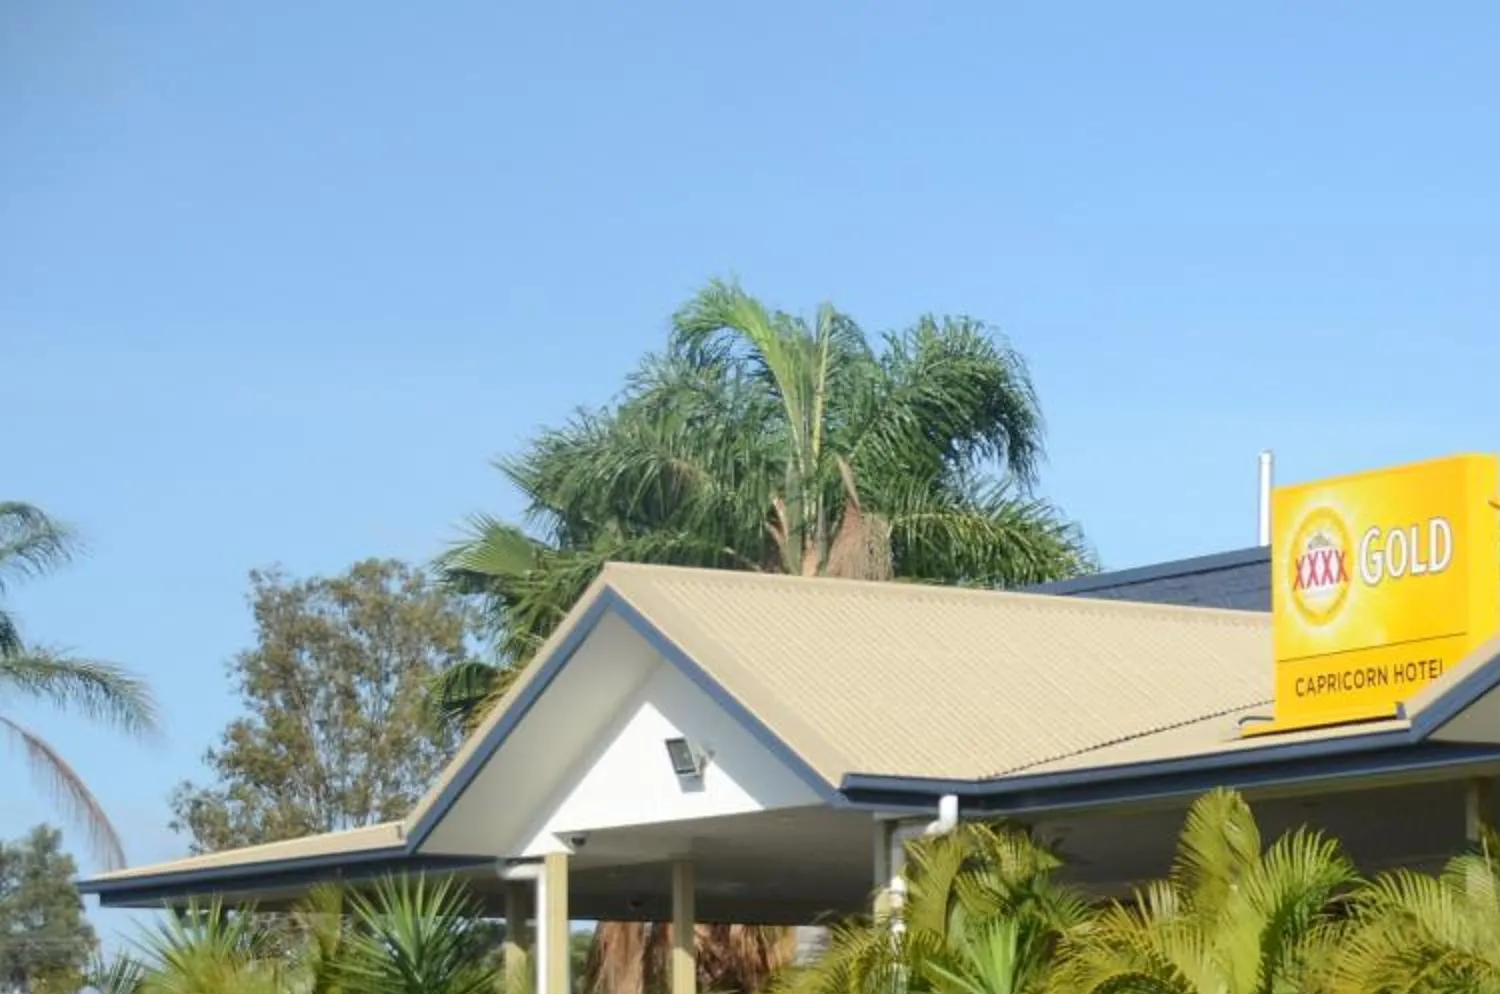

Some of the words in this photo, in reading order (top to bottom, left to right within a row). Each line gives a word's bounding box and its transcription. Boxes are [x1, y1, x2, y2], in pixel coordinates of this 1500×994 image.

[1294, 549, 1349, 591] XXXX
[1360, 517, 1452, 587] GOLD
[1296, 666, 1388, 697] CAPRICORN
